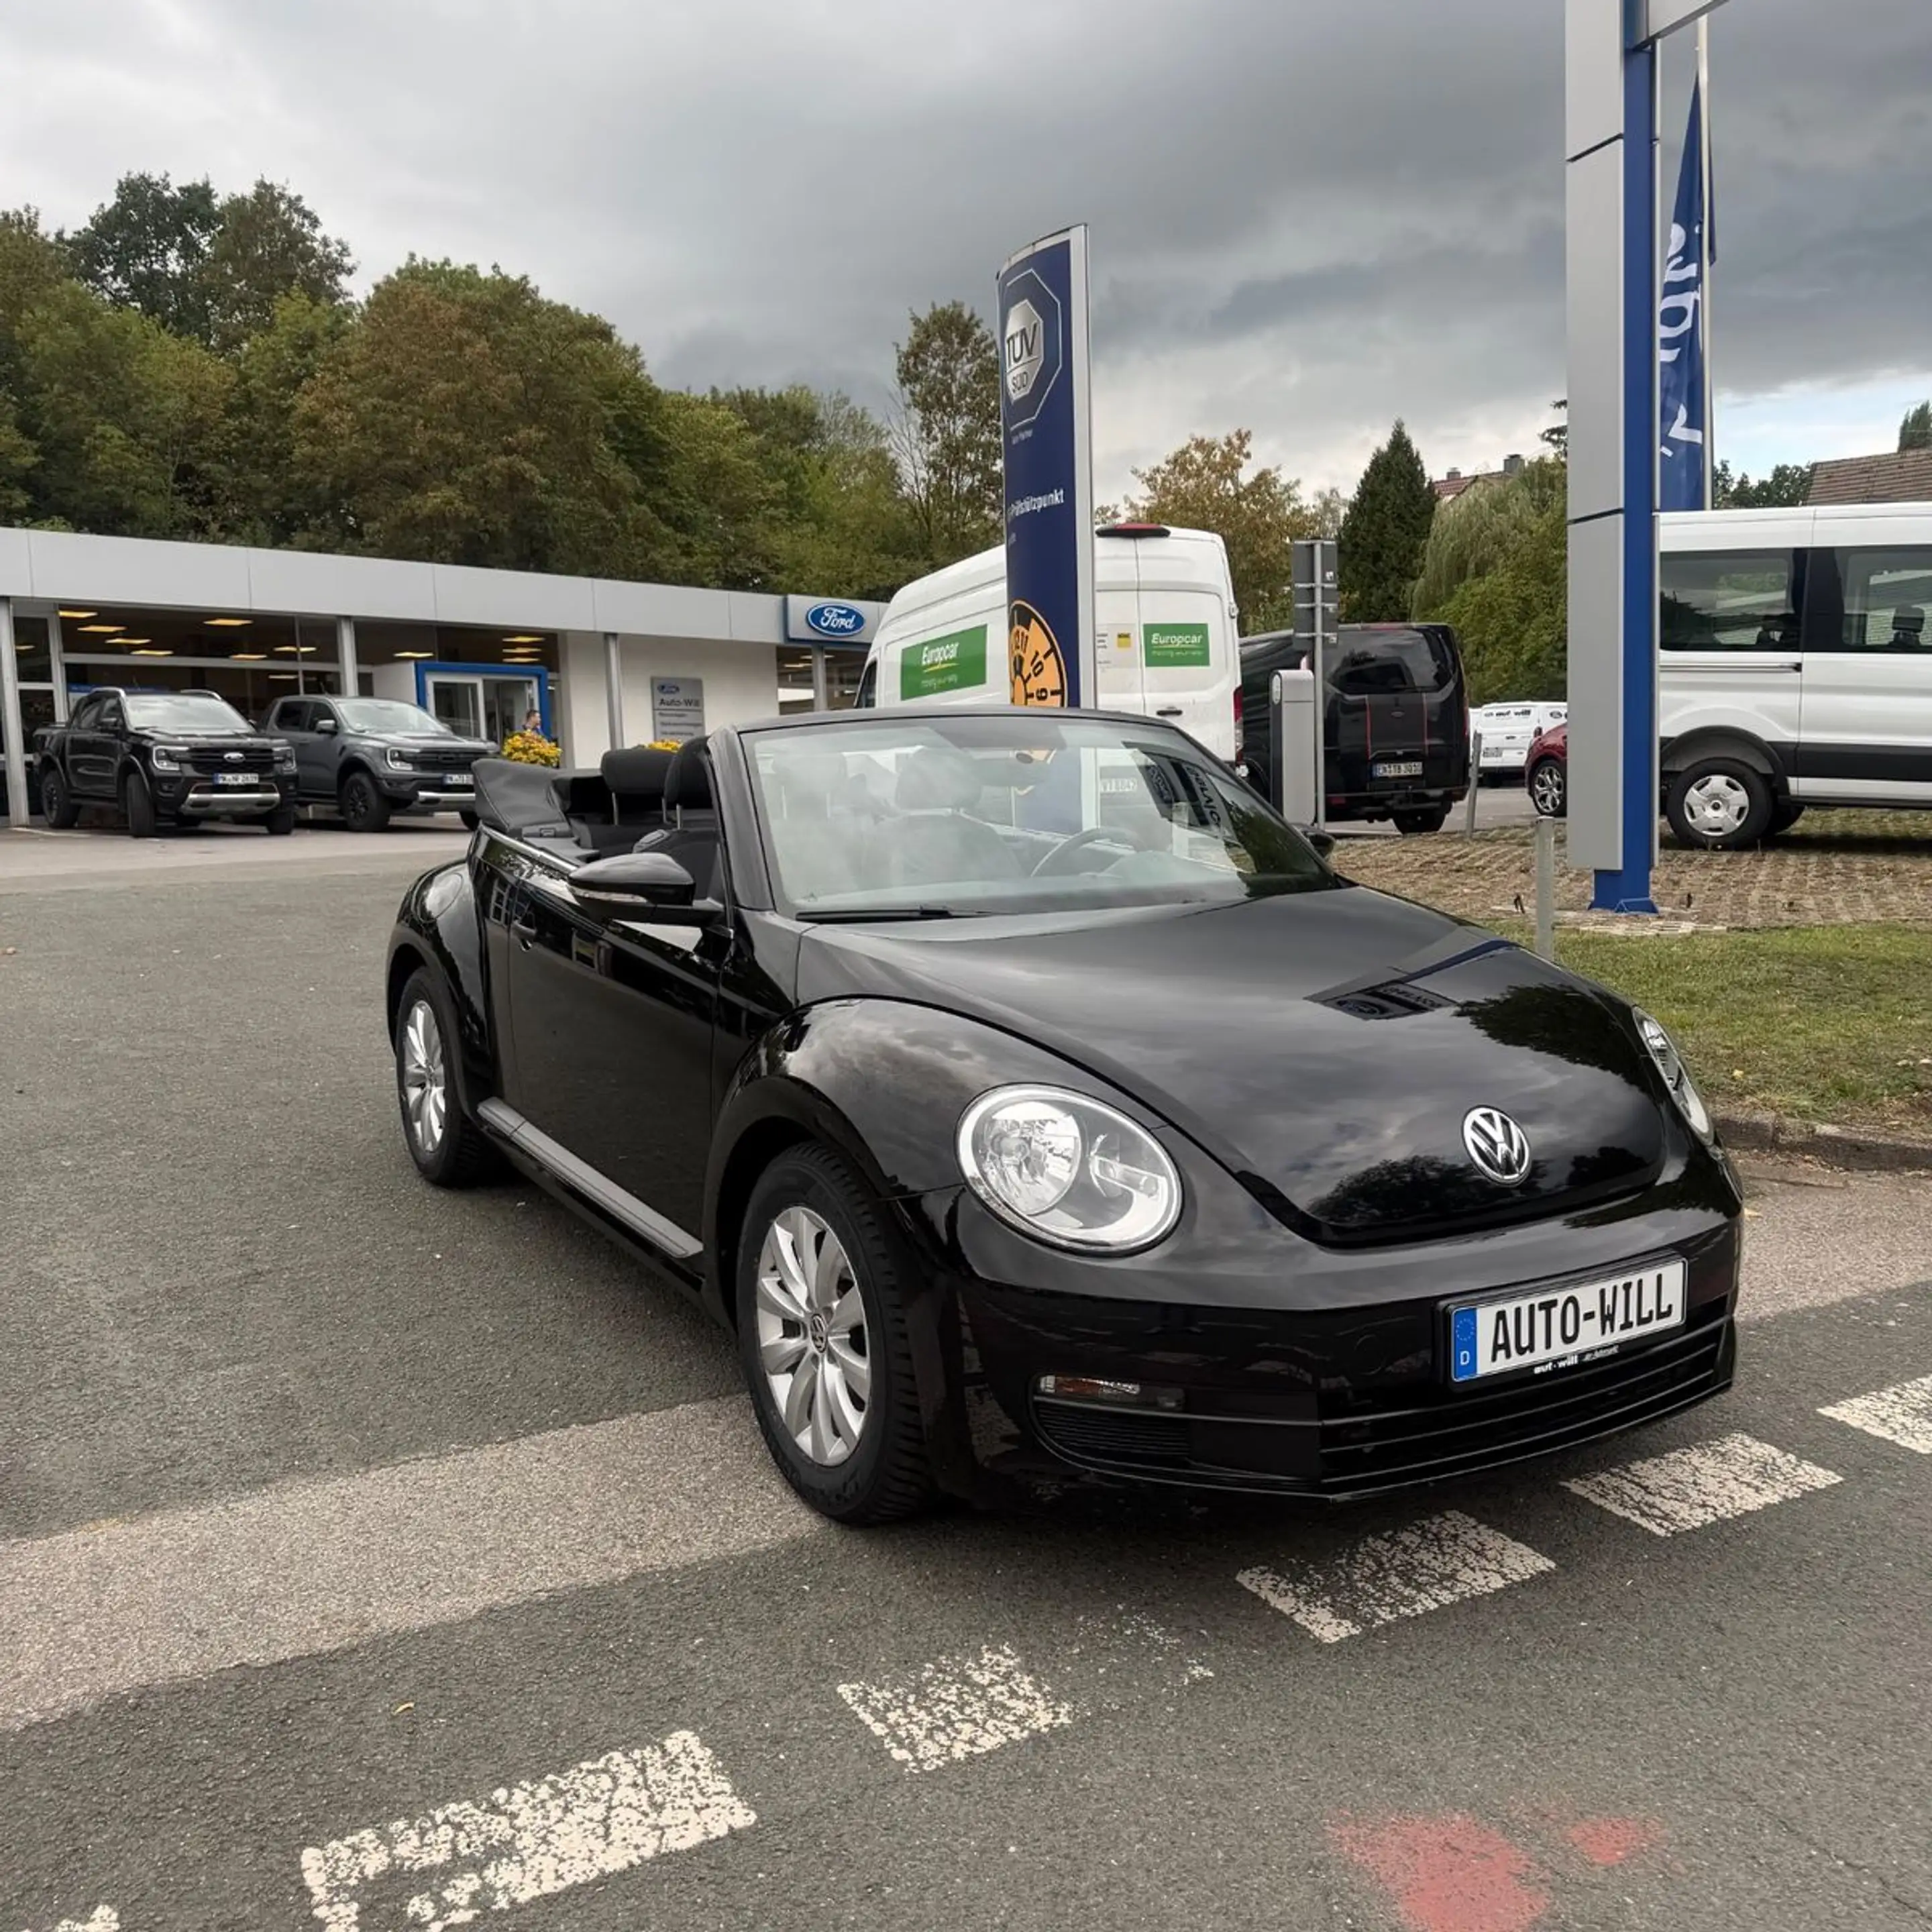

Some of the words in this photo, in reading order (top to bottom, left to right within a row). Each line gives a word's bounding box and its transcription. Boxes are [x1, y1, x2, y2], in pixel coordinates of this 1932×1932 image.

[1007, 321, 1038, 368] TÜV
[820, 607, 856, 629] Ford
[1151, 633, 1203, 647] Europcar
[922, 642, 959, 666] Europcar
[1030, 650, 1044, 678] 10
[1491, 1273, 1672, 1363] AUTO-WILL
[1460, 1350, 1470, 1365] D
